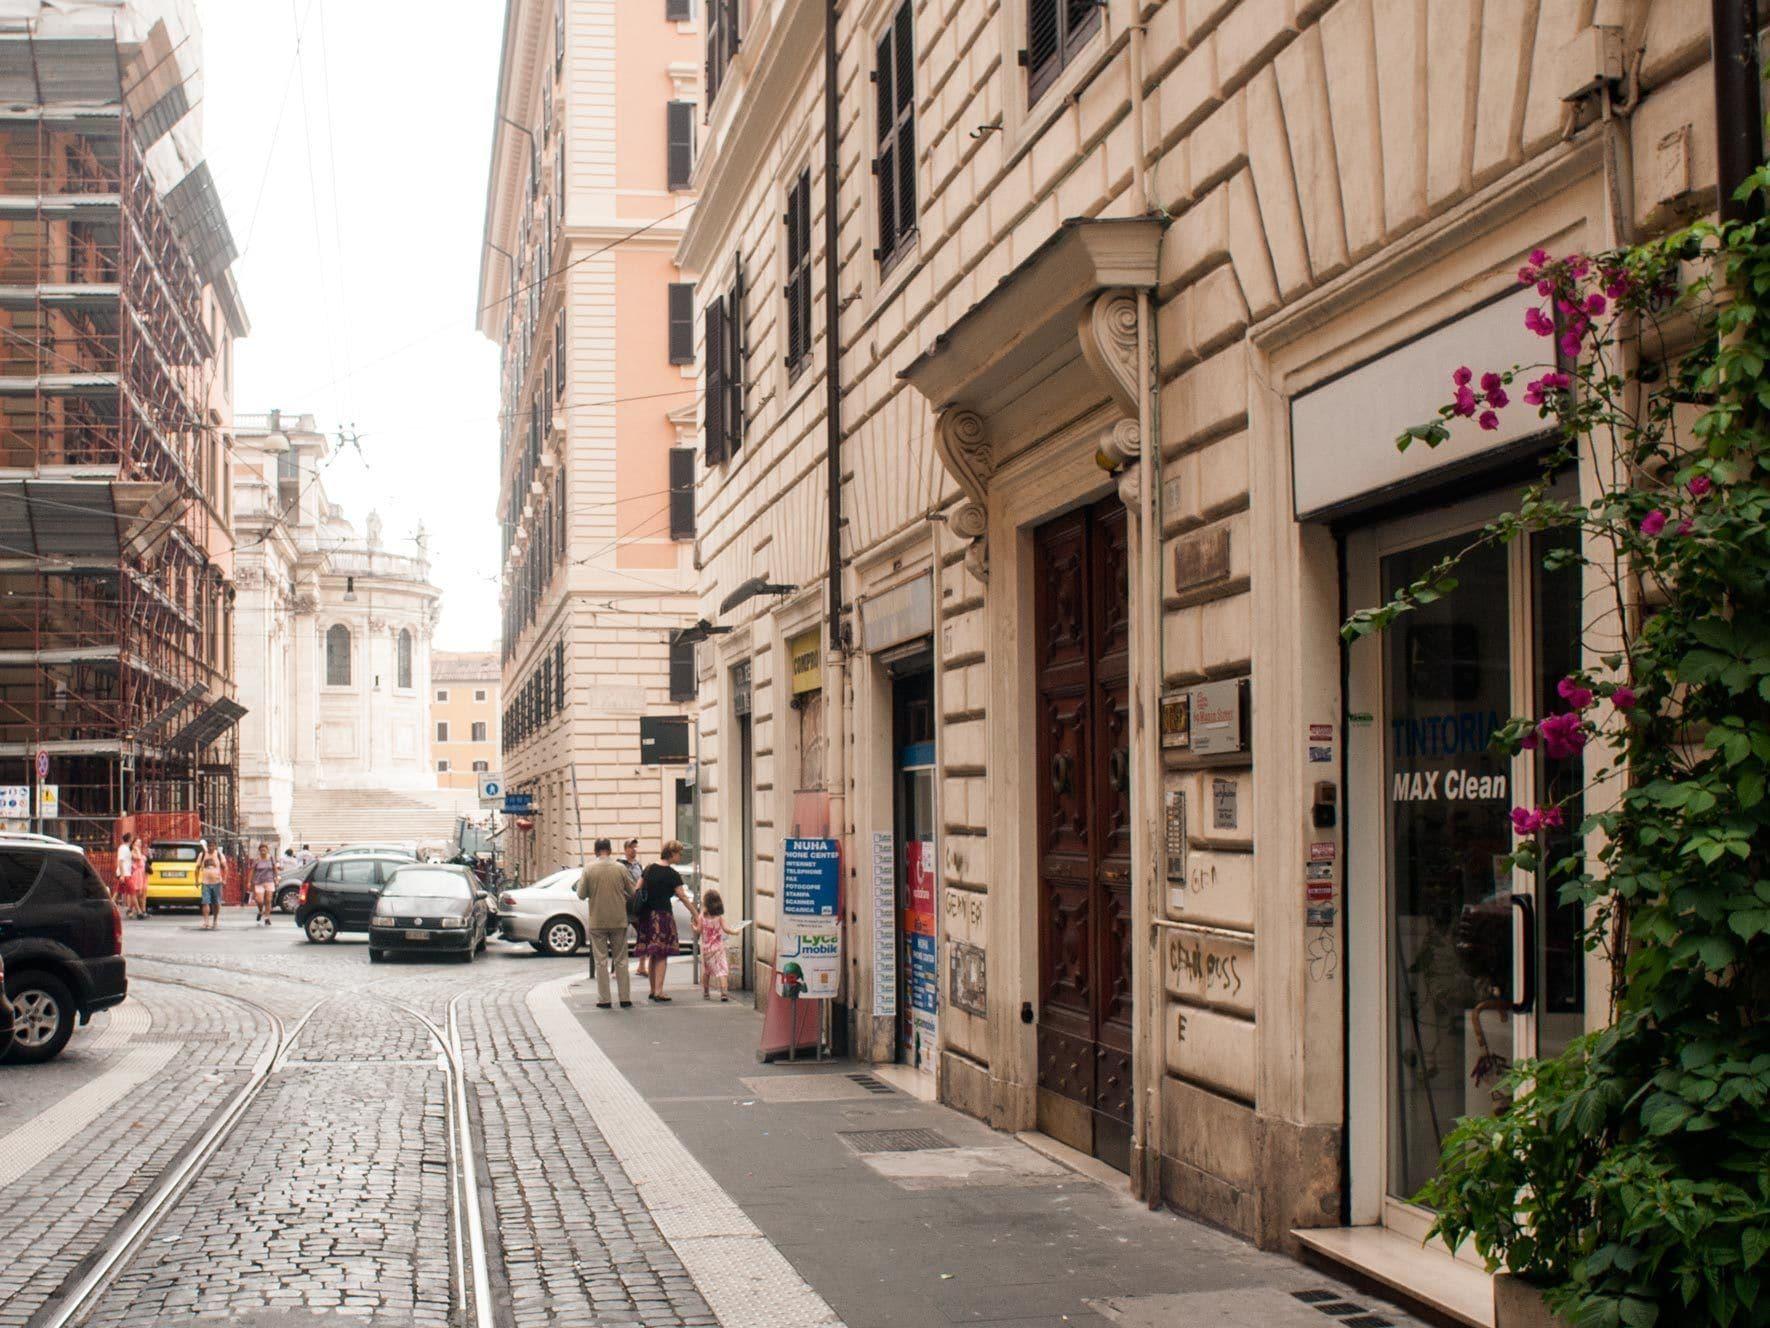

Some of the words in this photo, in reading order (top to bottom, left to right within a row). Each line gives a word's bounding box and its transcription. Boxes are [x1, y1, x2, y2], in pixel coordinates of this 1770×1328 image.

[1393, 710, 1500, 757] TINTORIA
[1393, 772, 1439, 801] MAX
[1445, 769, 1506, 800] Clean
[793, 841, 828, 850] NUHA
